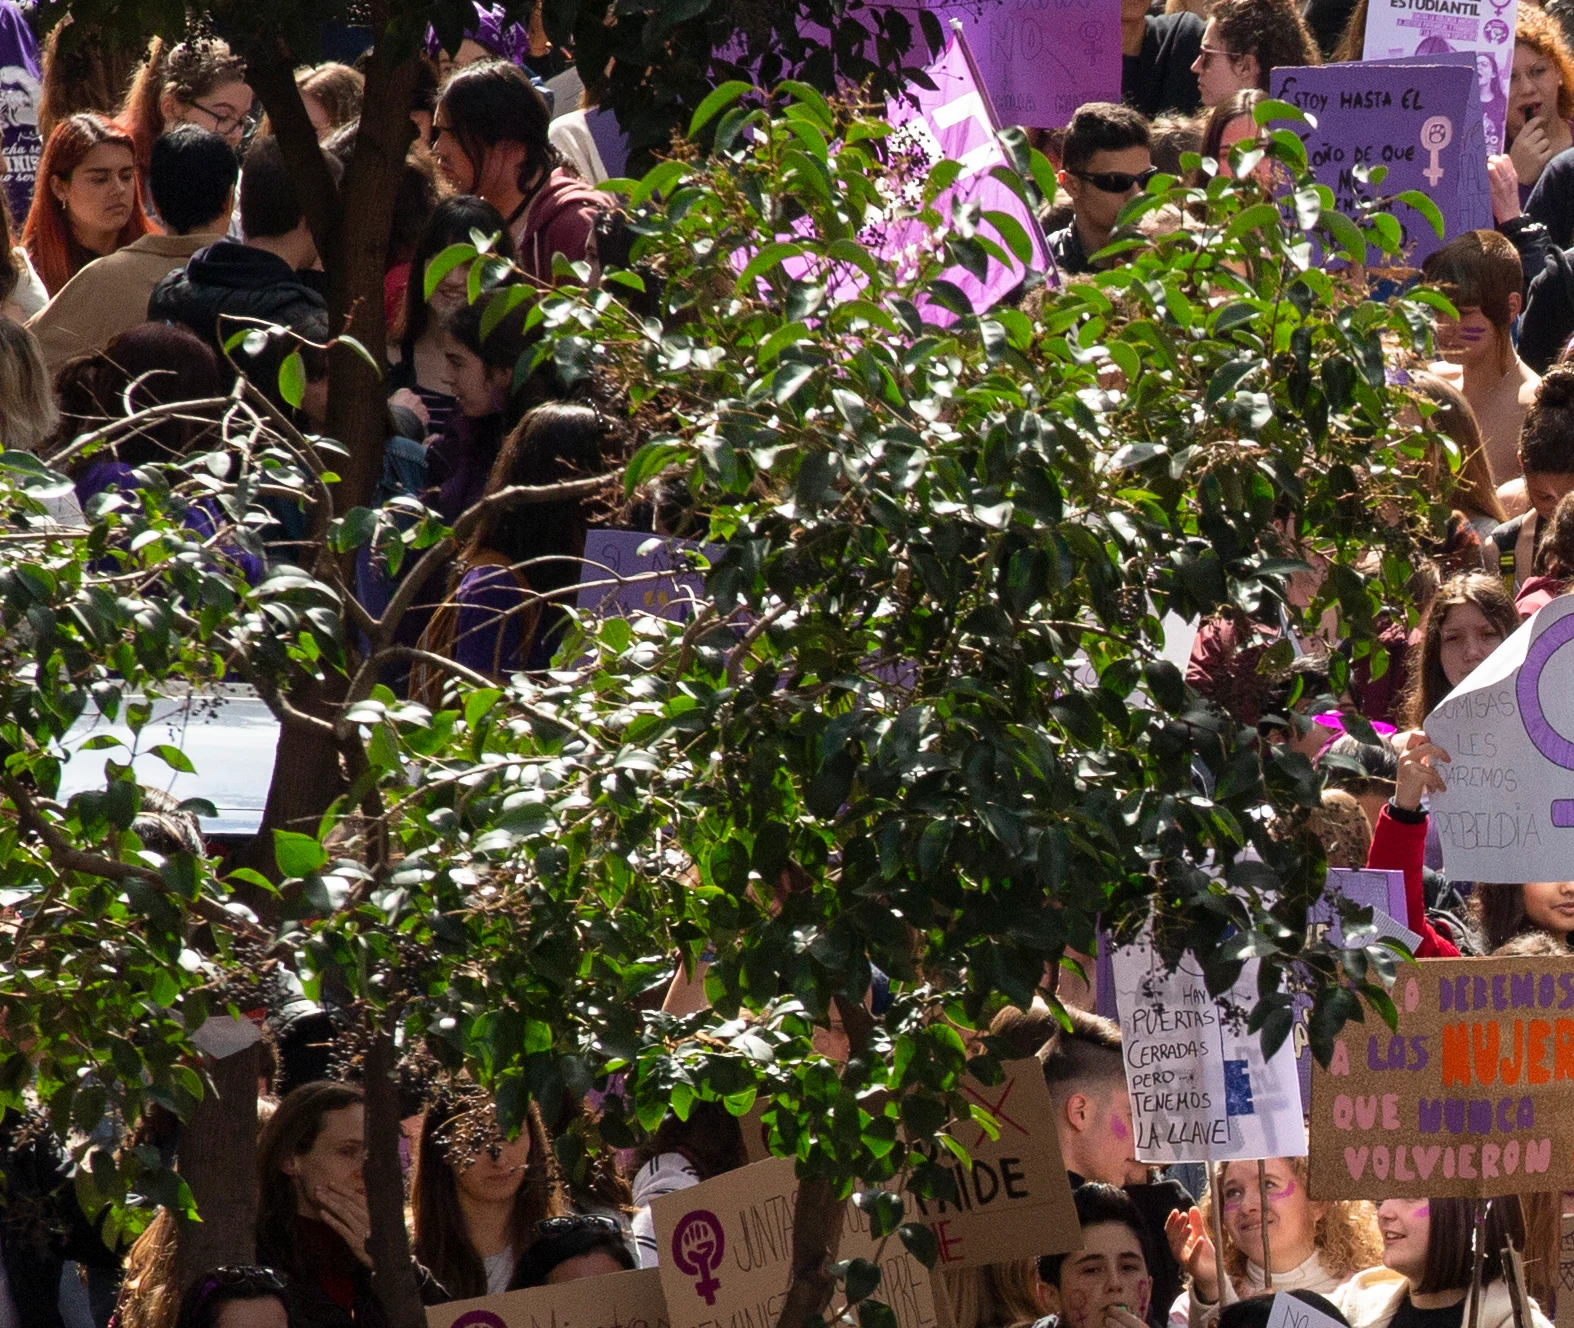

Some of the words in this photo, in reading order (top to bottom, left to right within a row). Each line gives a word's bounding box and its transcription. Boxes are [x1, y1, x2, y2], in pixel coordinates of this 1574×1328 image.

[1277, 77, 1328, 111] ESTOY
[1340, 91, 1392, 109] HASTA
[1401, 88, 1425, 110] EL
[1456, 732, 1497, 756] LES
[1131, 1007, 1216, 1035] PUERTAS
[1127, 1039, 1208, 1070] CERRADAS
[1131, 1090, 1212, 1113] TENEMOS
[1332, 1093, 1401, 1131] QUE
[1417, 1095, 1536, 1135] NUNCA
[1136, 1122, 1165, 1149] LA
[1168, 1118, 1230, 1145] LLAVE
[1343, 1138, 1552, 1182] VOLVIERON
